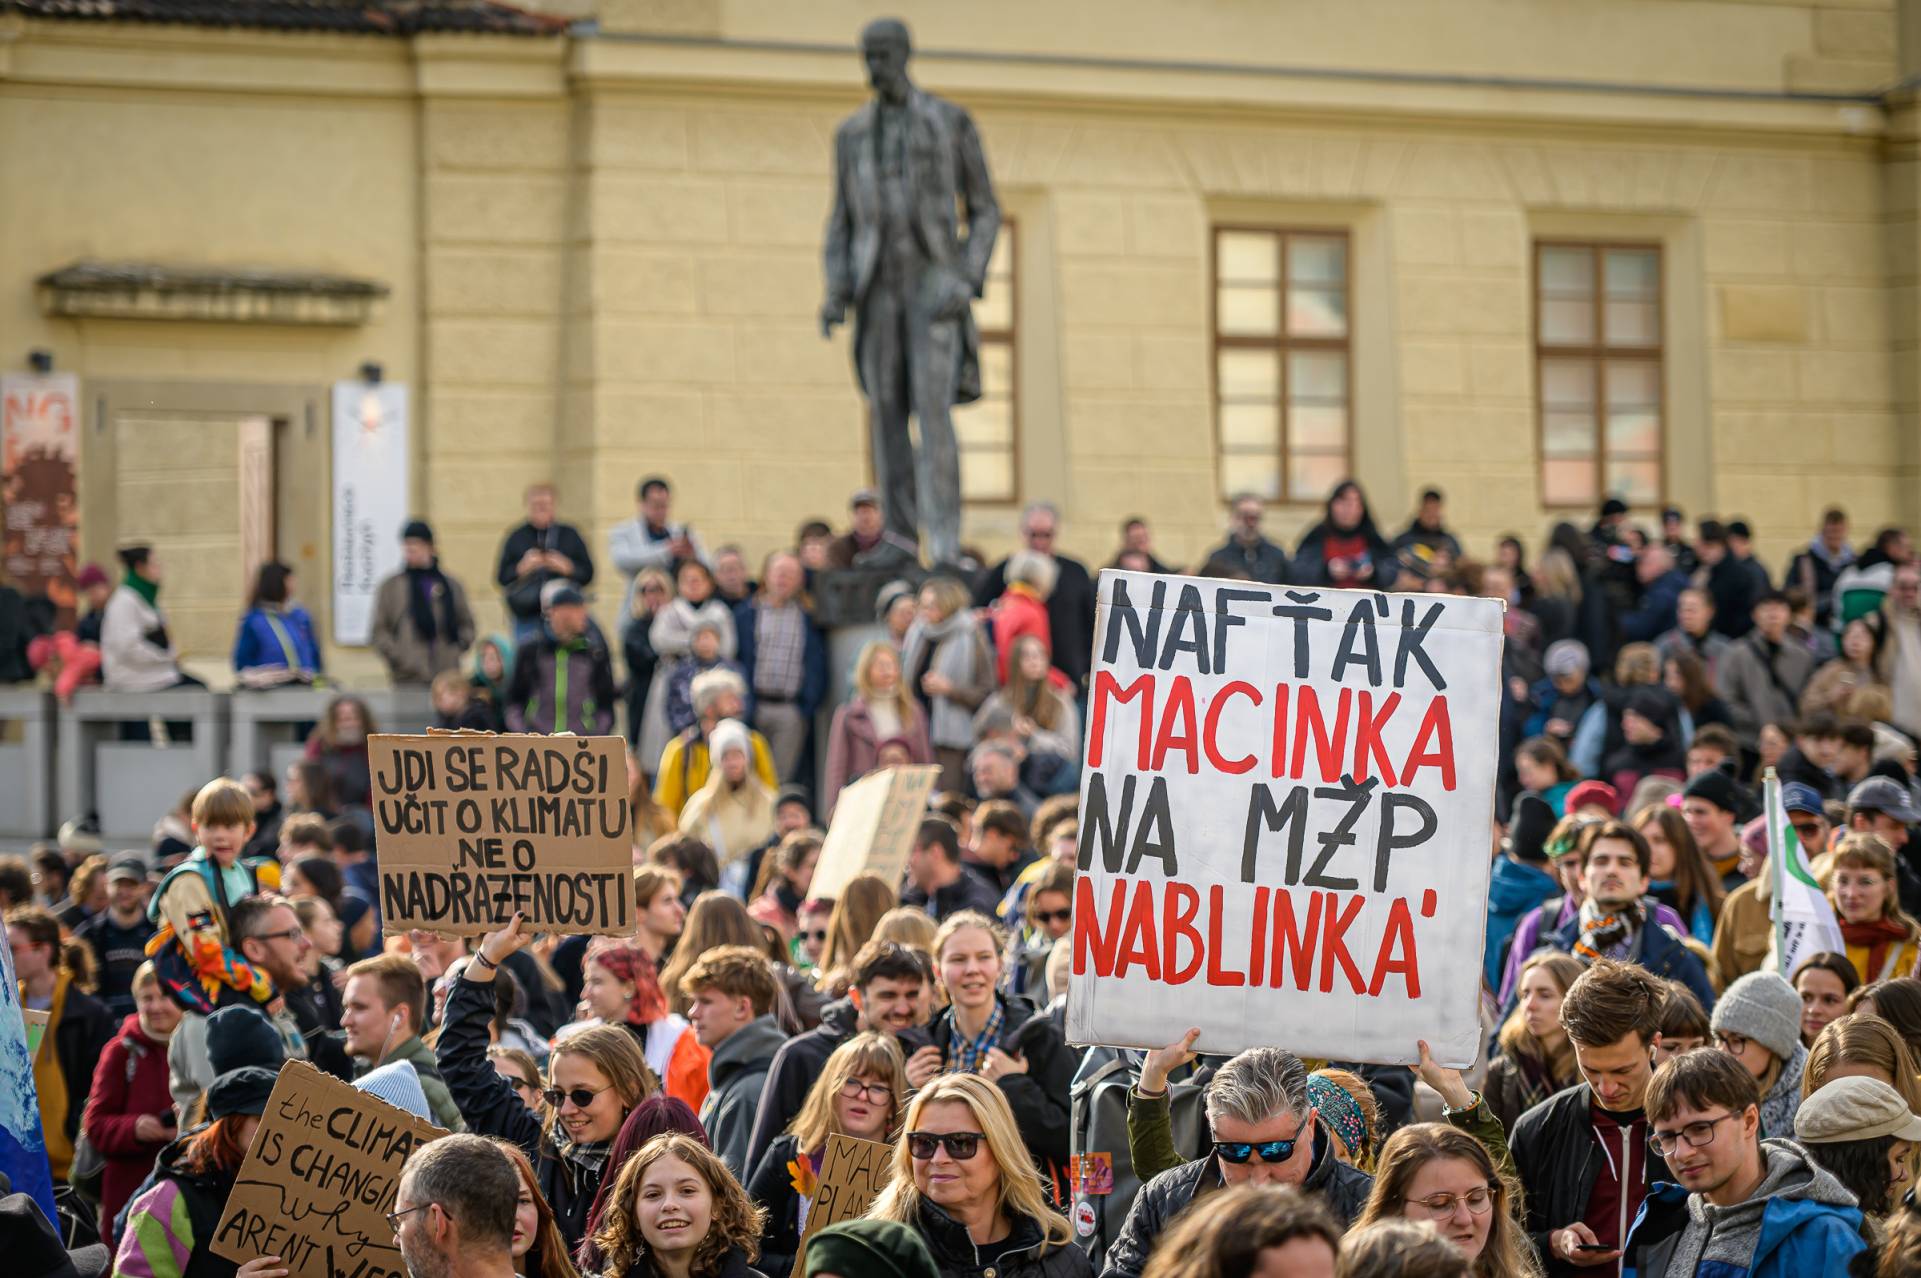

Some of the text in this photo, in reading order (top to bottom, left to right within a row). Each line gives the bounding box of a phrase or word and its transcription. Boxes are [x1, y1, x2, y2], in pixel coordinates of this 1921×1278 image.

[1102, 578, 1447, 691] NAFŤÁK
[378, 739, 607, 795] JDI SE RADŠI
[1088, 670, 1457, 791] MACINKA
[379, 793, 626, 839] UČIT O KLIMATU
[458, 837, 536, 872] NE O
[1077, 772, 1438, 892] NA MŽP
[1073, 876, 1437, 999] NABLINKÁ
[279, 1092, 324, 1129] the
[255, 1129, 398, 1214] IS CHANGIN
